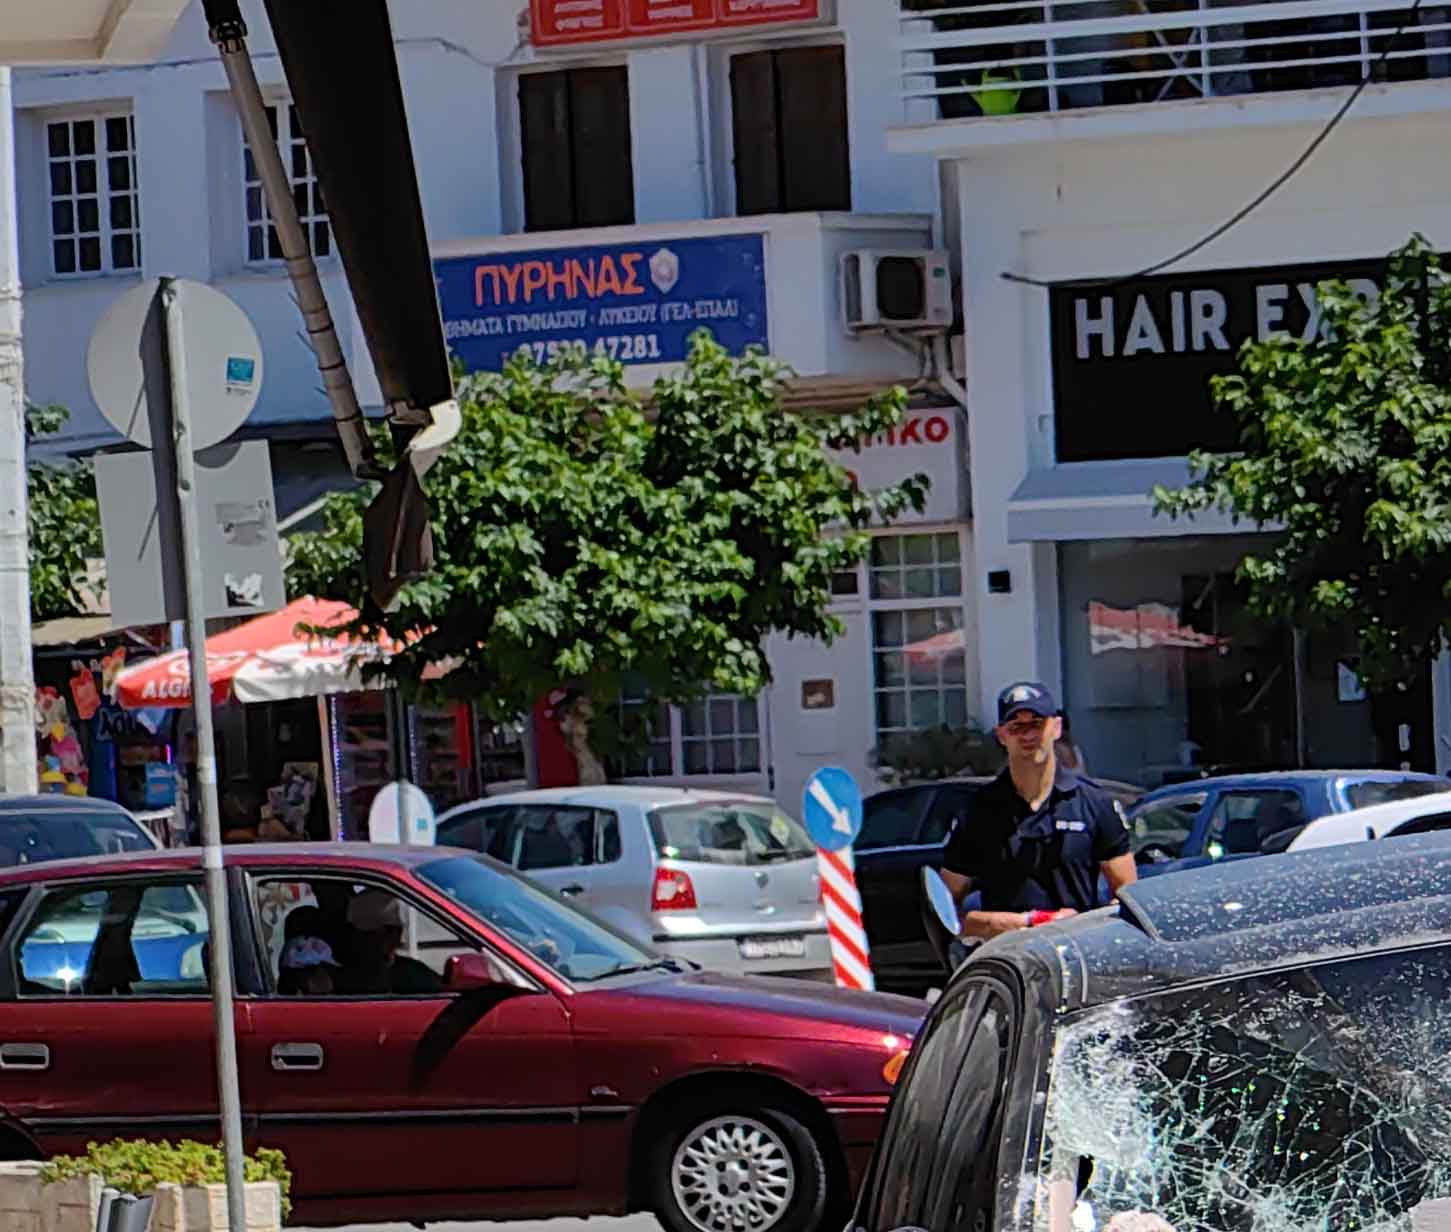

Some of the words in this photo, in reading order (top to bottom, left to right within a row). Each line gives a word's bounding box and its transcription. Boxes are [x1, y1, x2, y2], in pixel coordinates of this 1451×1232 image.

[474, 253, 646, 306] ΠΥΡΗΝΑΣ
[445, 315, 504, 339] ΘΗΜΑΤΑ
[507, 309, 586, 333] ΓΥΜΝΑΣΙΟΥ
[600, 304, 658, 325] ΛΥΚΕΙΟΥ
[1074, 289, 1231, 360] HAIR
[593, 334, 661, 362] 47281
